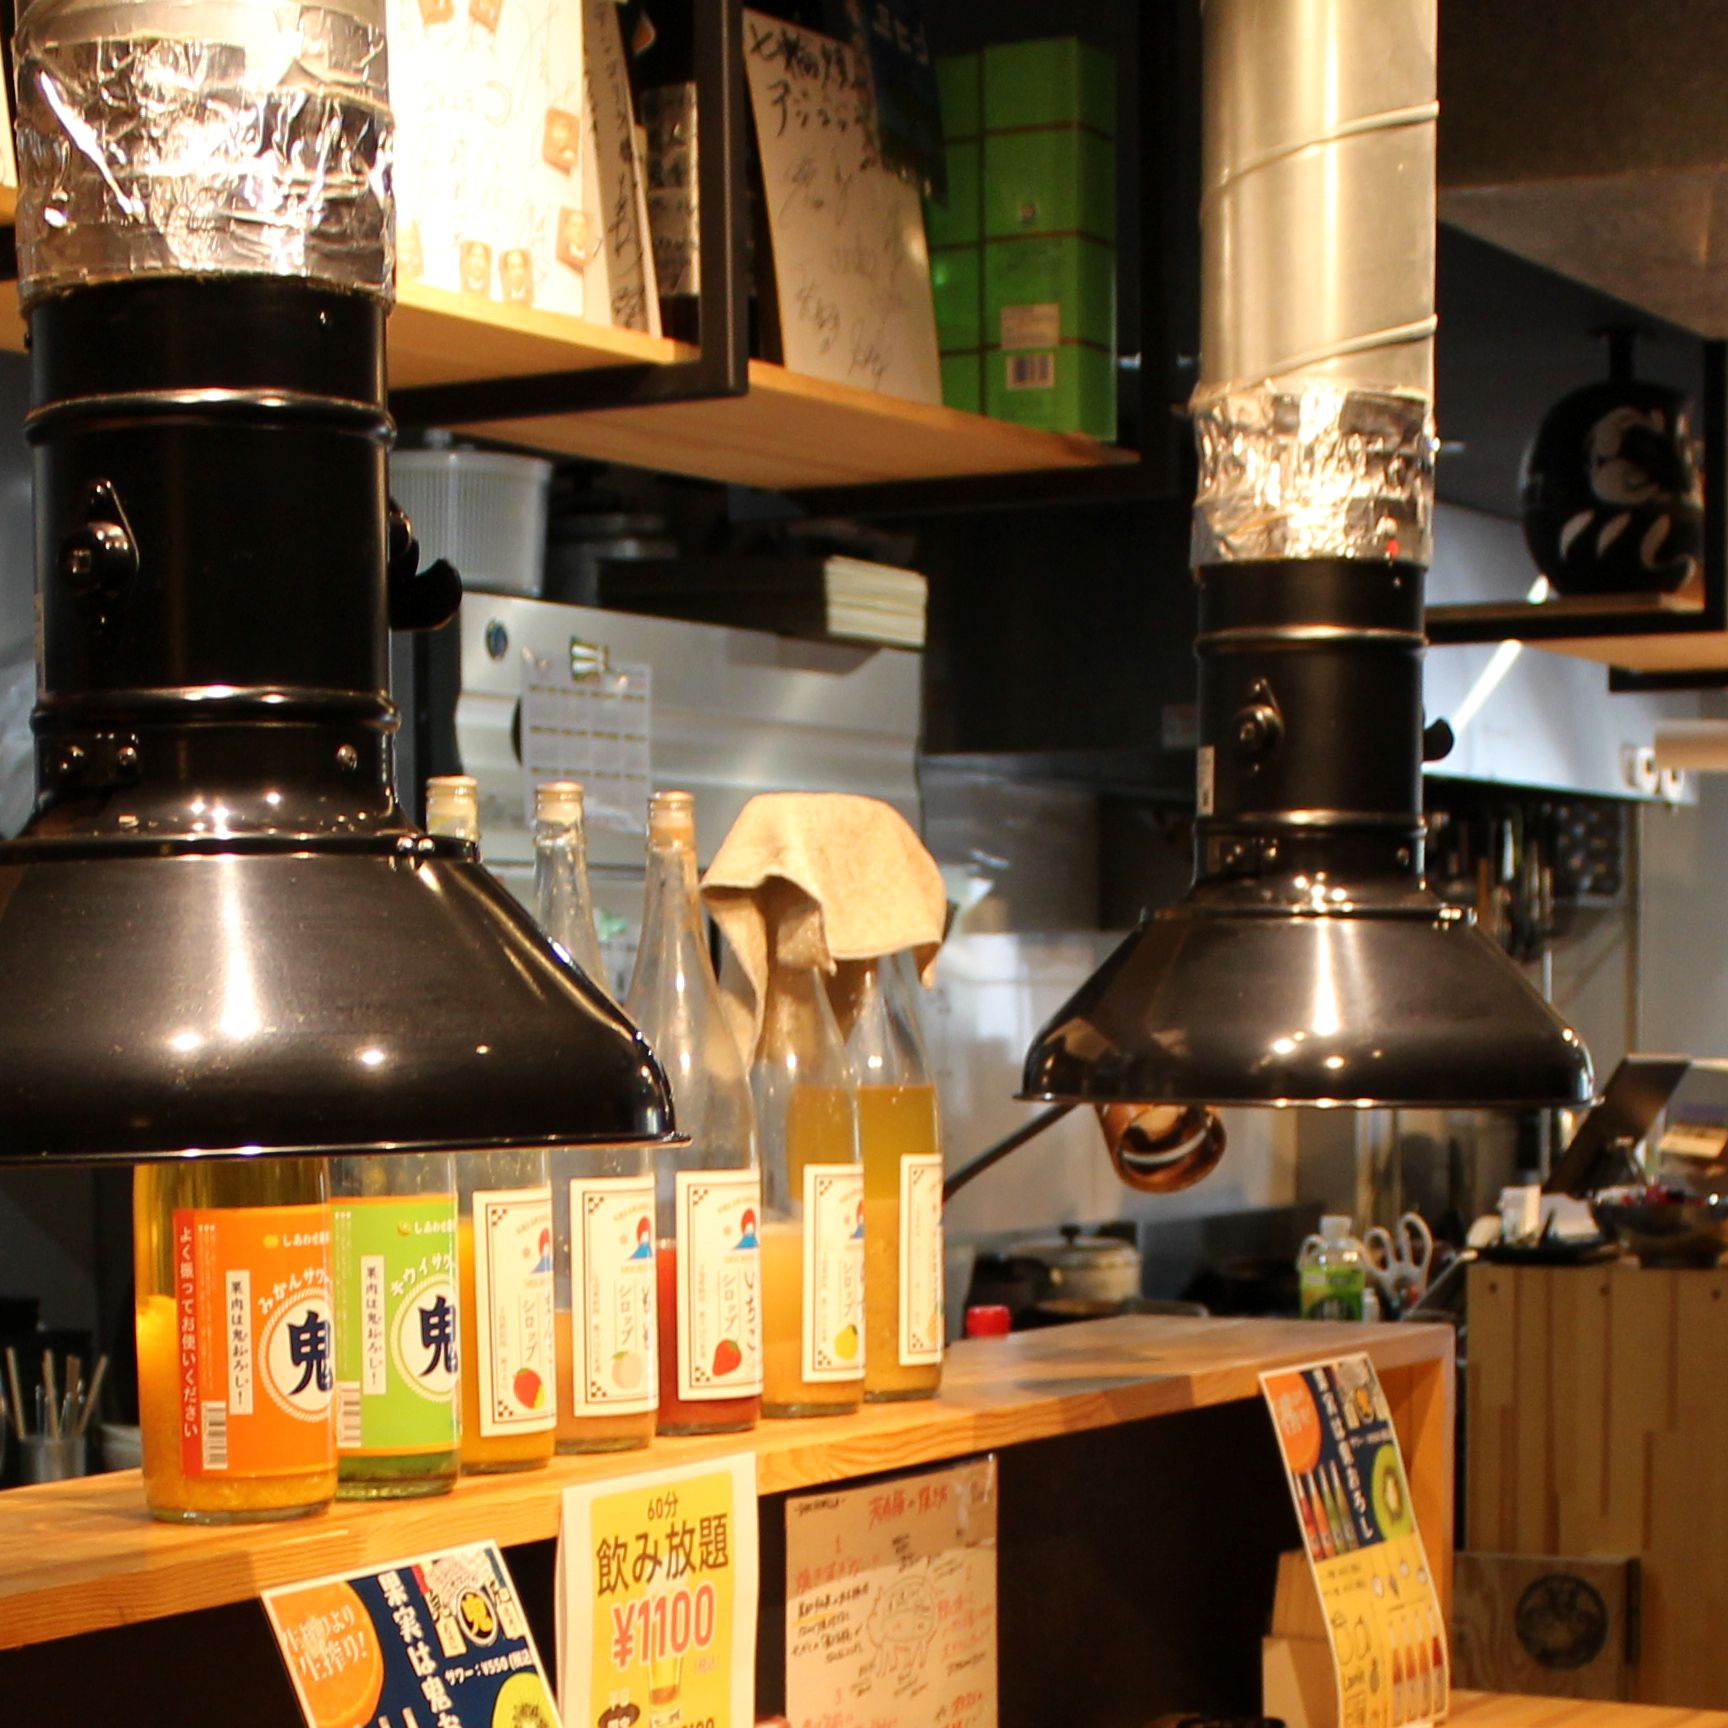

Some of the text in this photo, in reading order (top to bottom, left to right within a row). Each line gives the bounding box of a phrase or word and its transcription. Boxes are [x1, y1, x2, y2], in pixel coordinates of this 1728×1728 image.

[179, 1227, 199, 1438] よく振ってお使いください
[648, 1491, 679, 1521] 60分
[596, 1513, 729, 1599] 飲み放題
[612, 1583, 714, 1669] ¥1100
